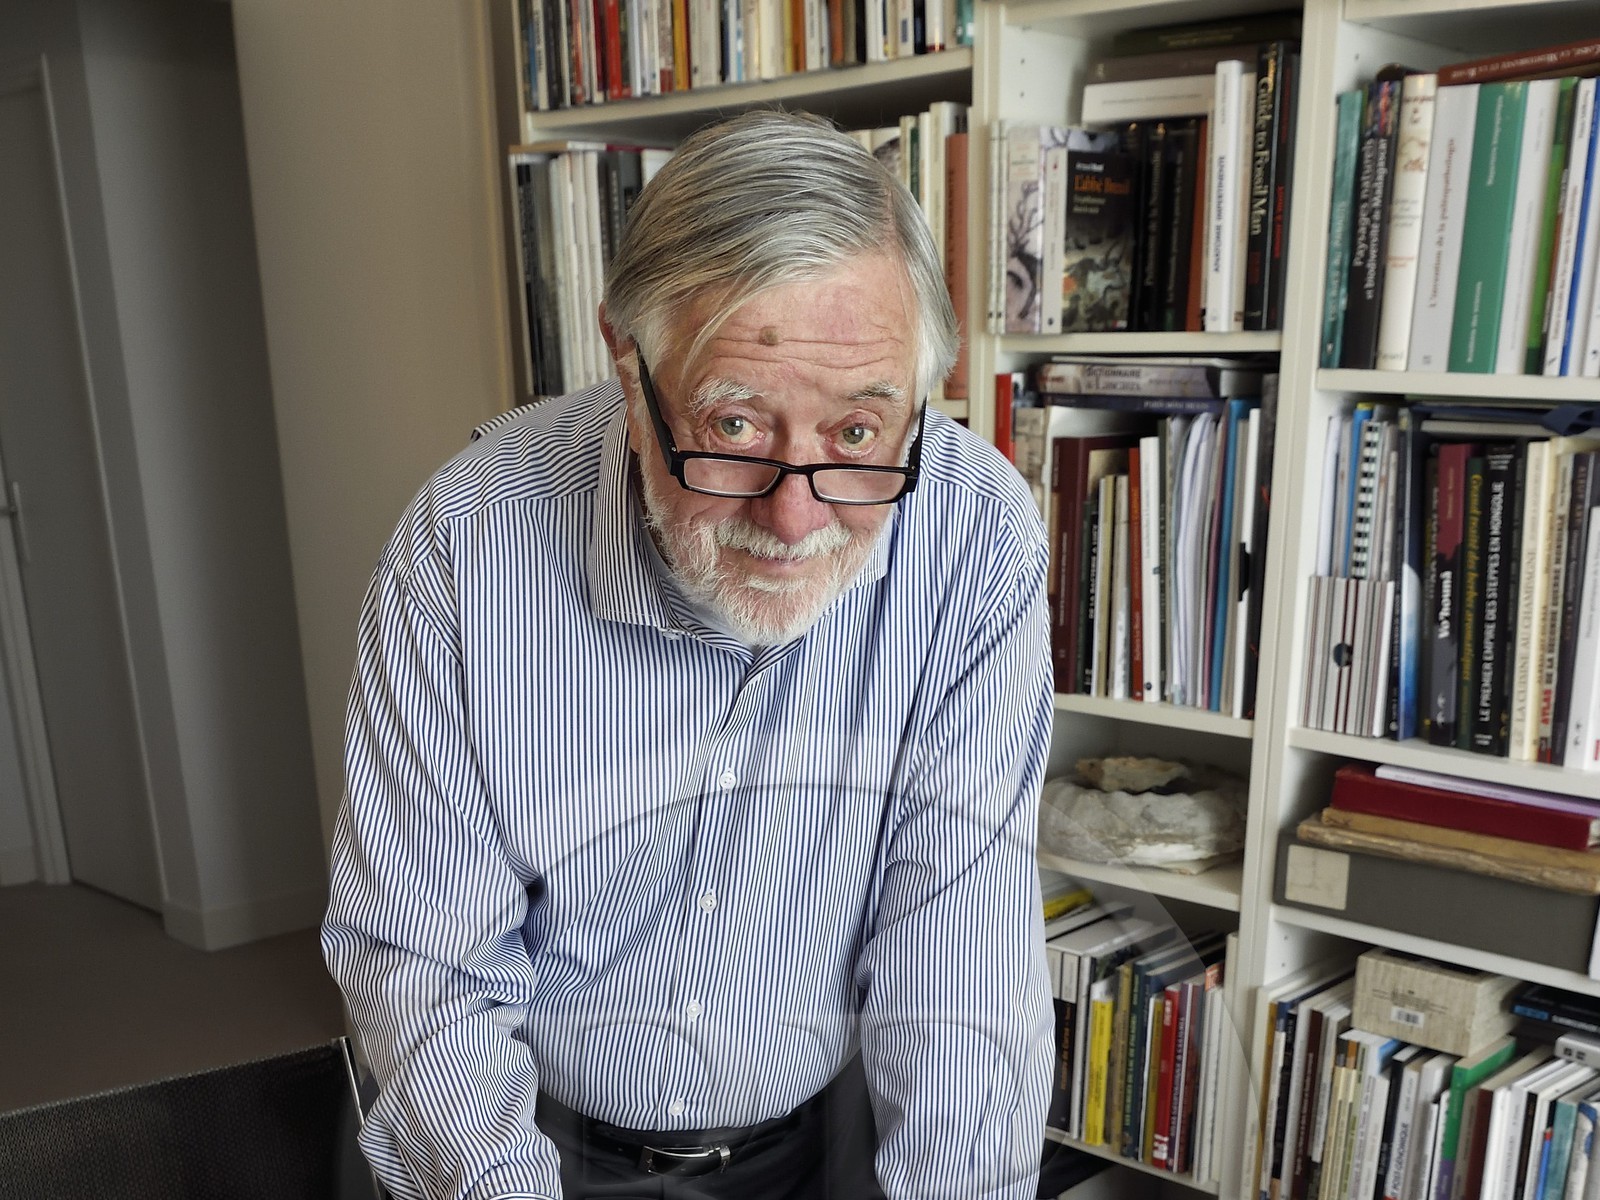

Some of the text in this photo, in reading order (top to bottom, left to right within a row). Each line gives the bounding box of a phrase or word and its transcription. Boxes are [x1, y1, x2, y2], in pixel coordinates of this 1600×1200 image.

[1252, 76, 1274, 235] Guide to Fossil Man
[1353, 202, 1372, 266] Paysages
[1490, 482, 1504, 535] MONGOLIE
[1490, 537, 1500, 552] EN
[1486, 553, 1500, 599] STEPPES
[1485, 600, 1497, 621] DES
[1483, 623, 1496, 661] EMPIRE
[1480, 662, 1493, 707] PREMIER
[1480, 709, 1490, 722] LE
[1541, 689, 1552, 725] ATLAS
